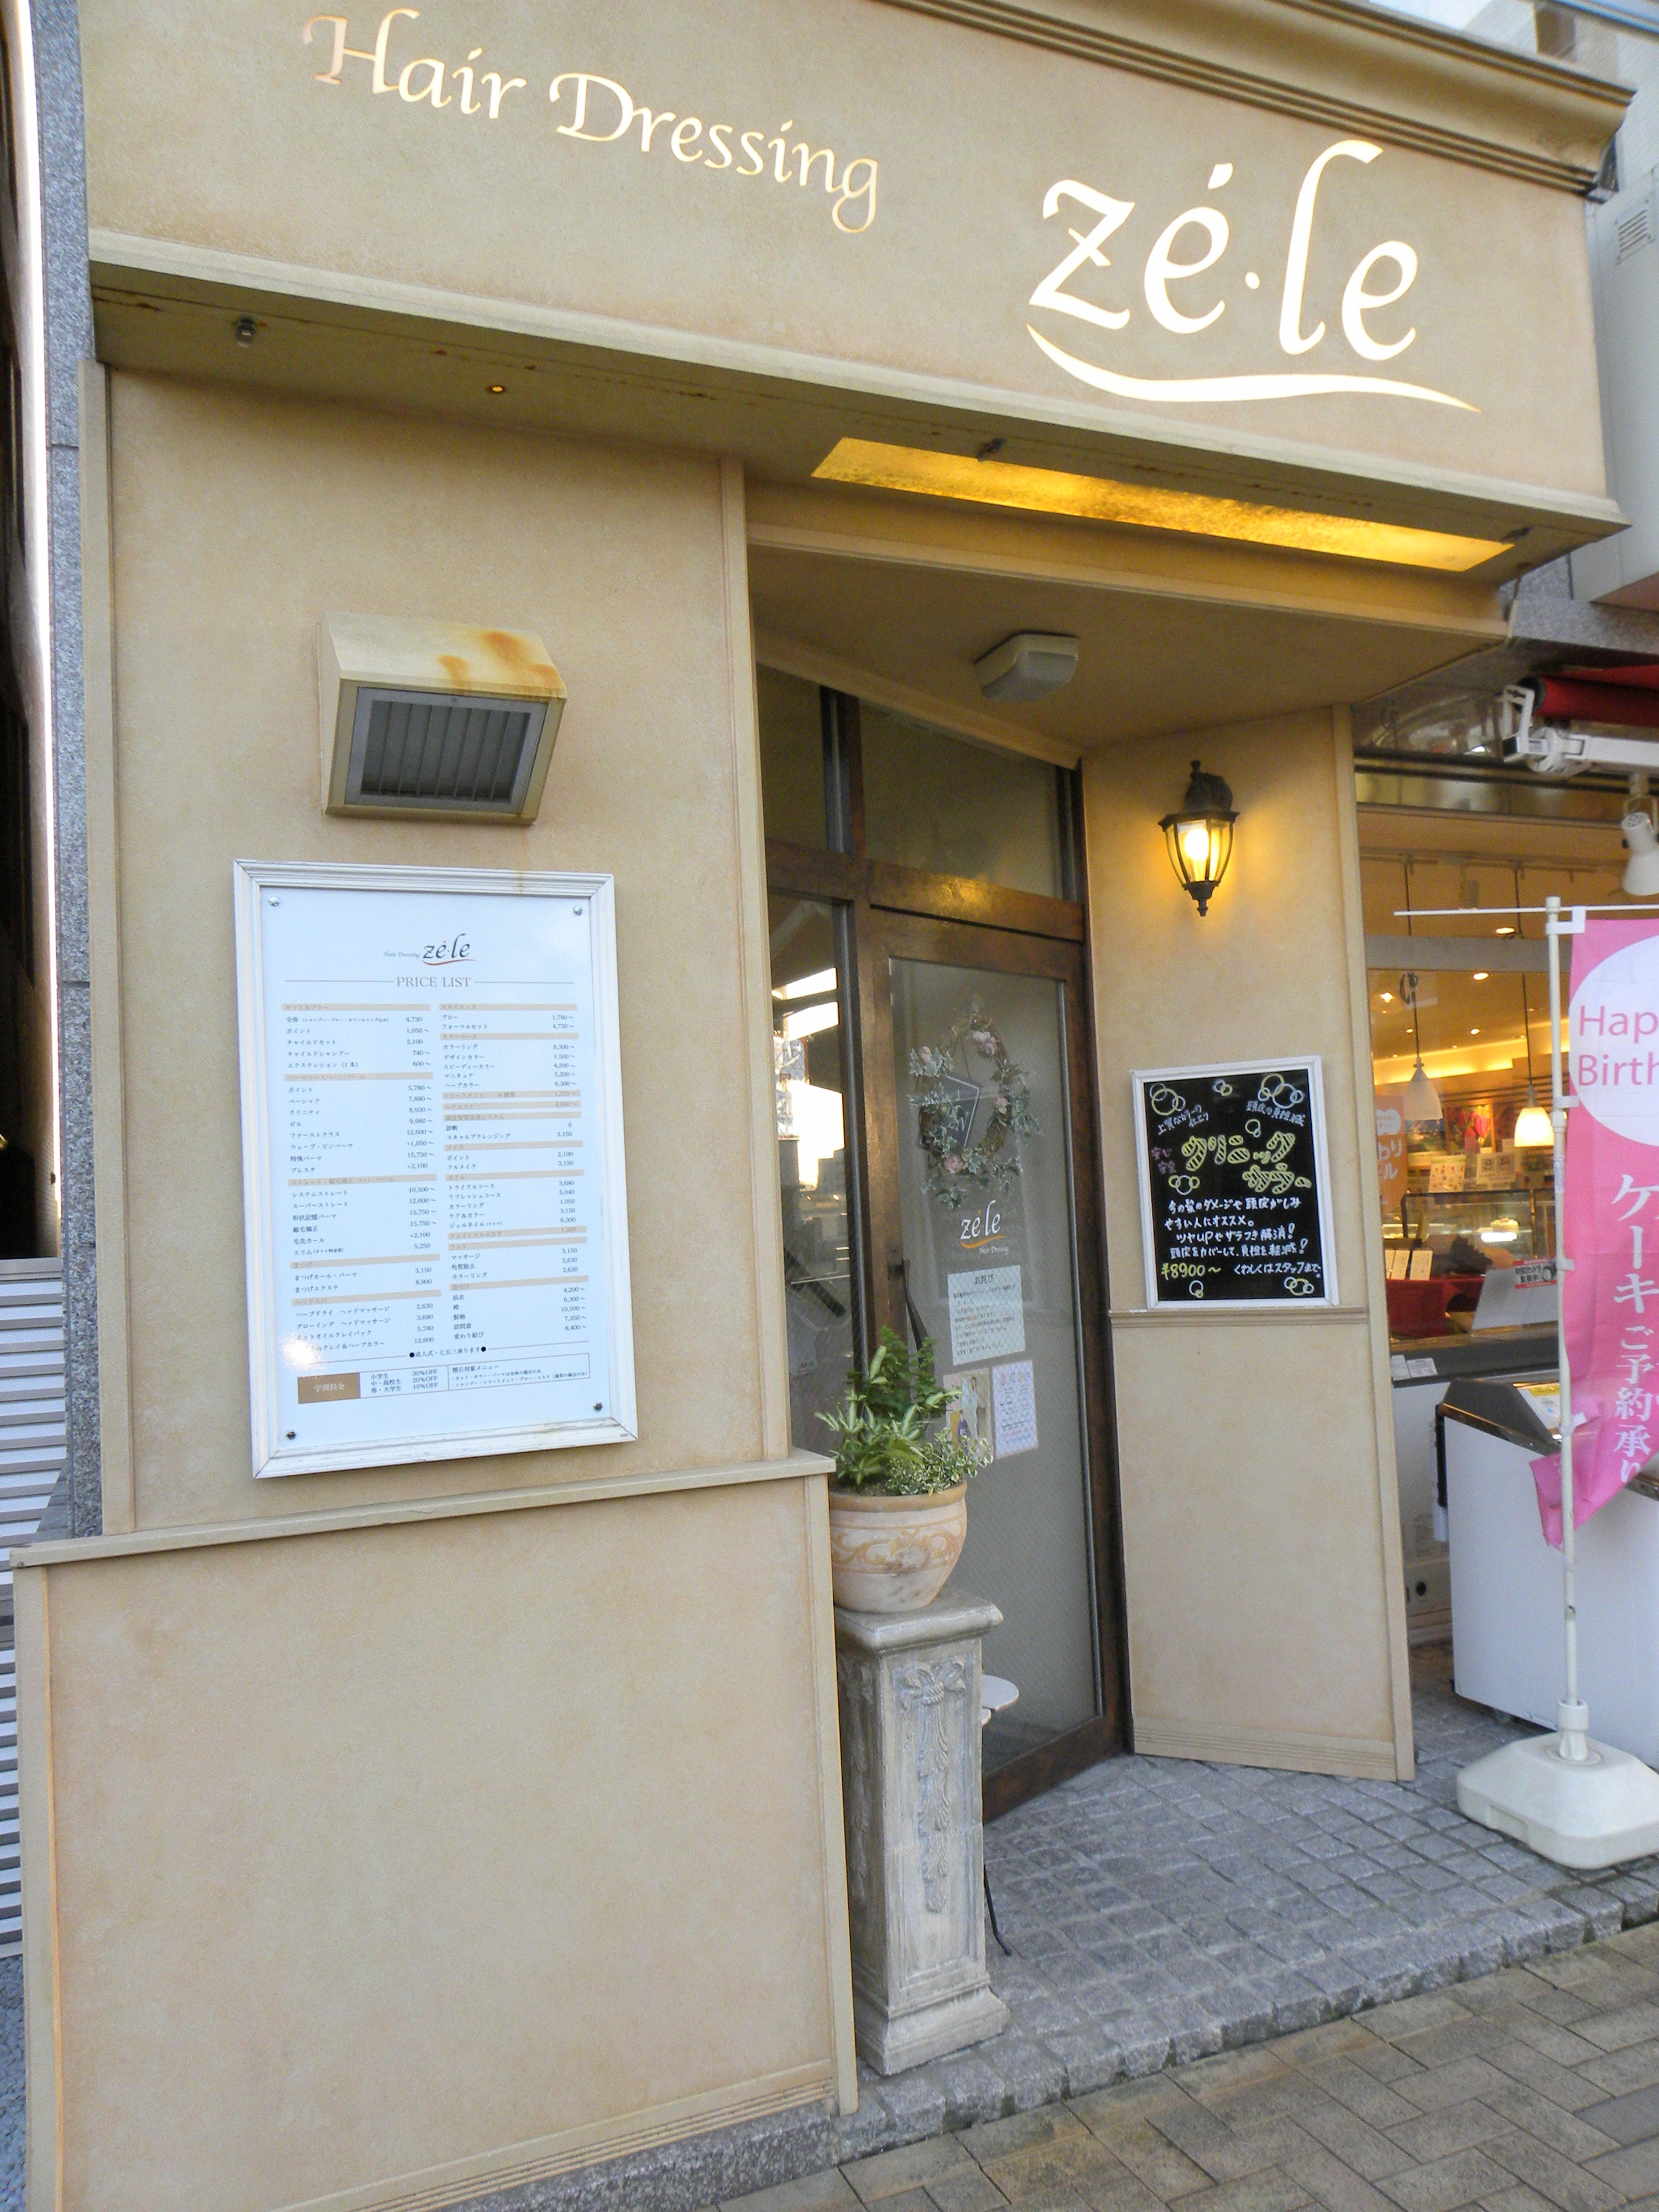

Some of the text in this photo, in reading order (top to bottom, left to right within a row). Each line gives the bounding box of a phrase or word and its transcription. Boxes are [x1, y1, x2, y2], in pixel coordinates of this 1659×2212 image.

[303, 8, 878, 233] Hair Dressing
[397, 976, 471, 987] PRICE LIST
[1579, 1005, 1659, 1043] Hap
[1181, 1131, 1296, 1172] クリニック
